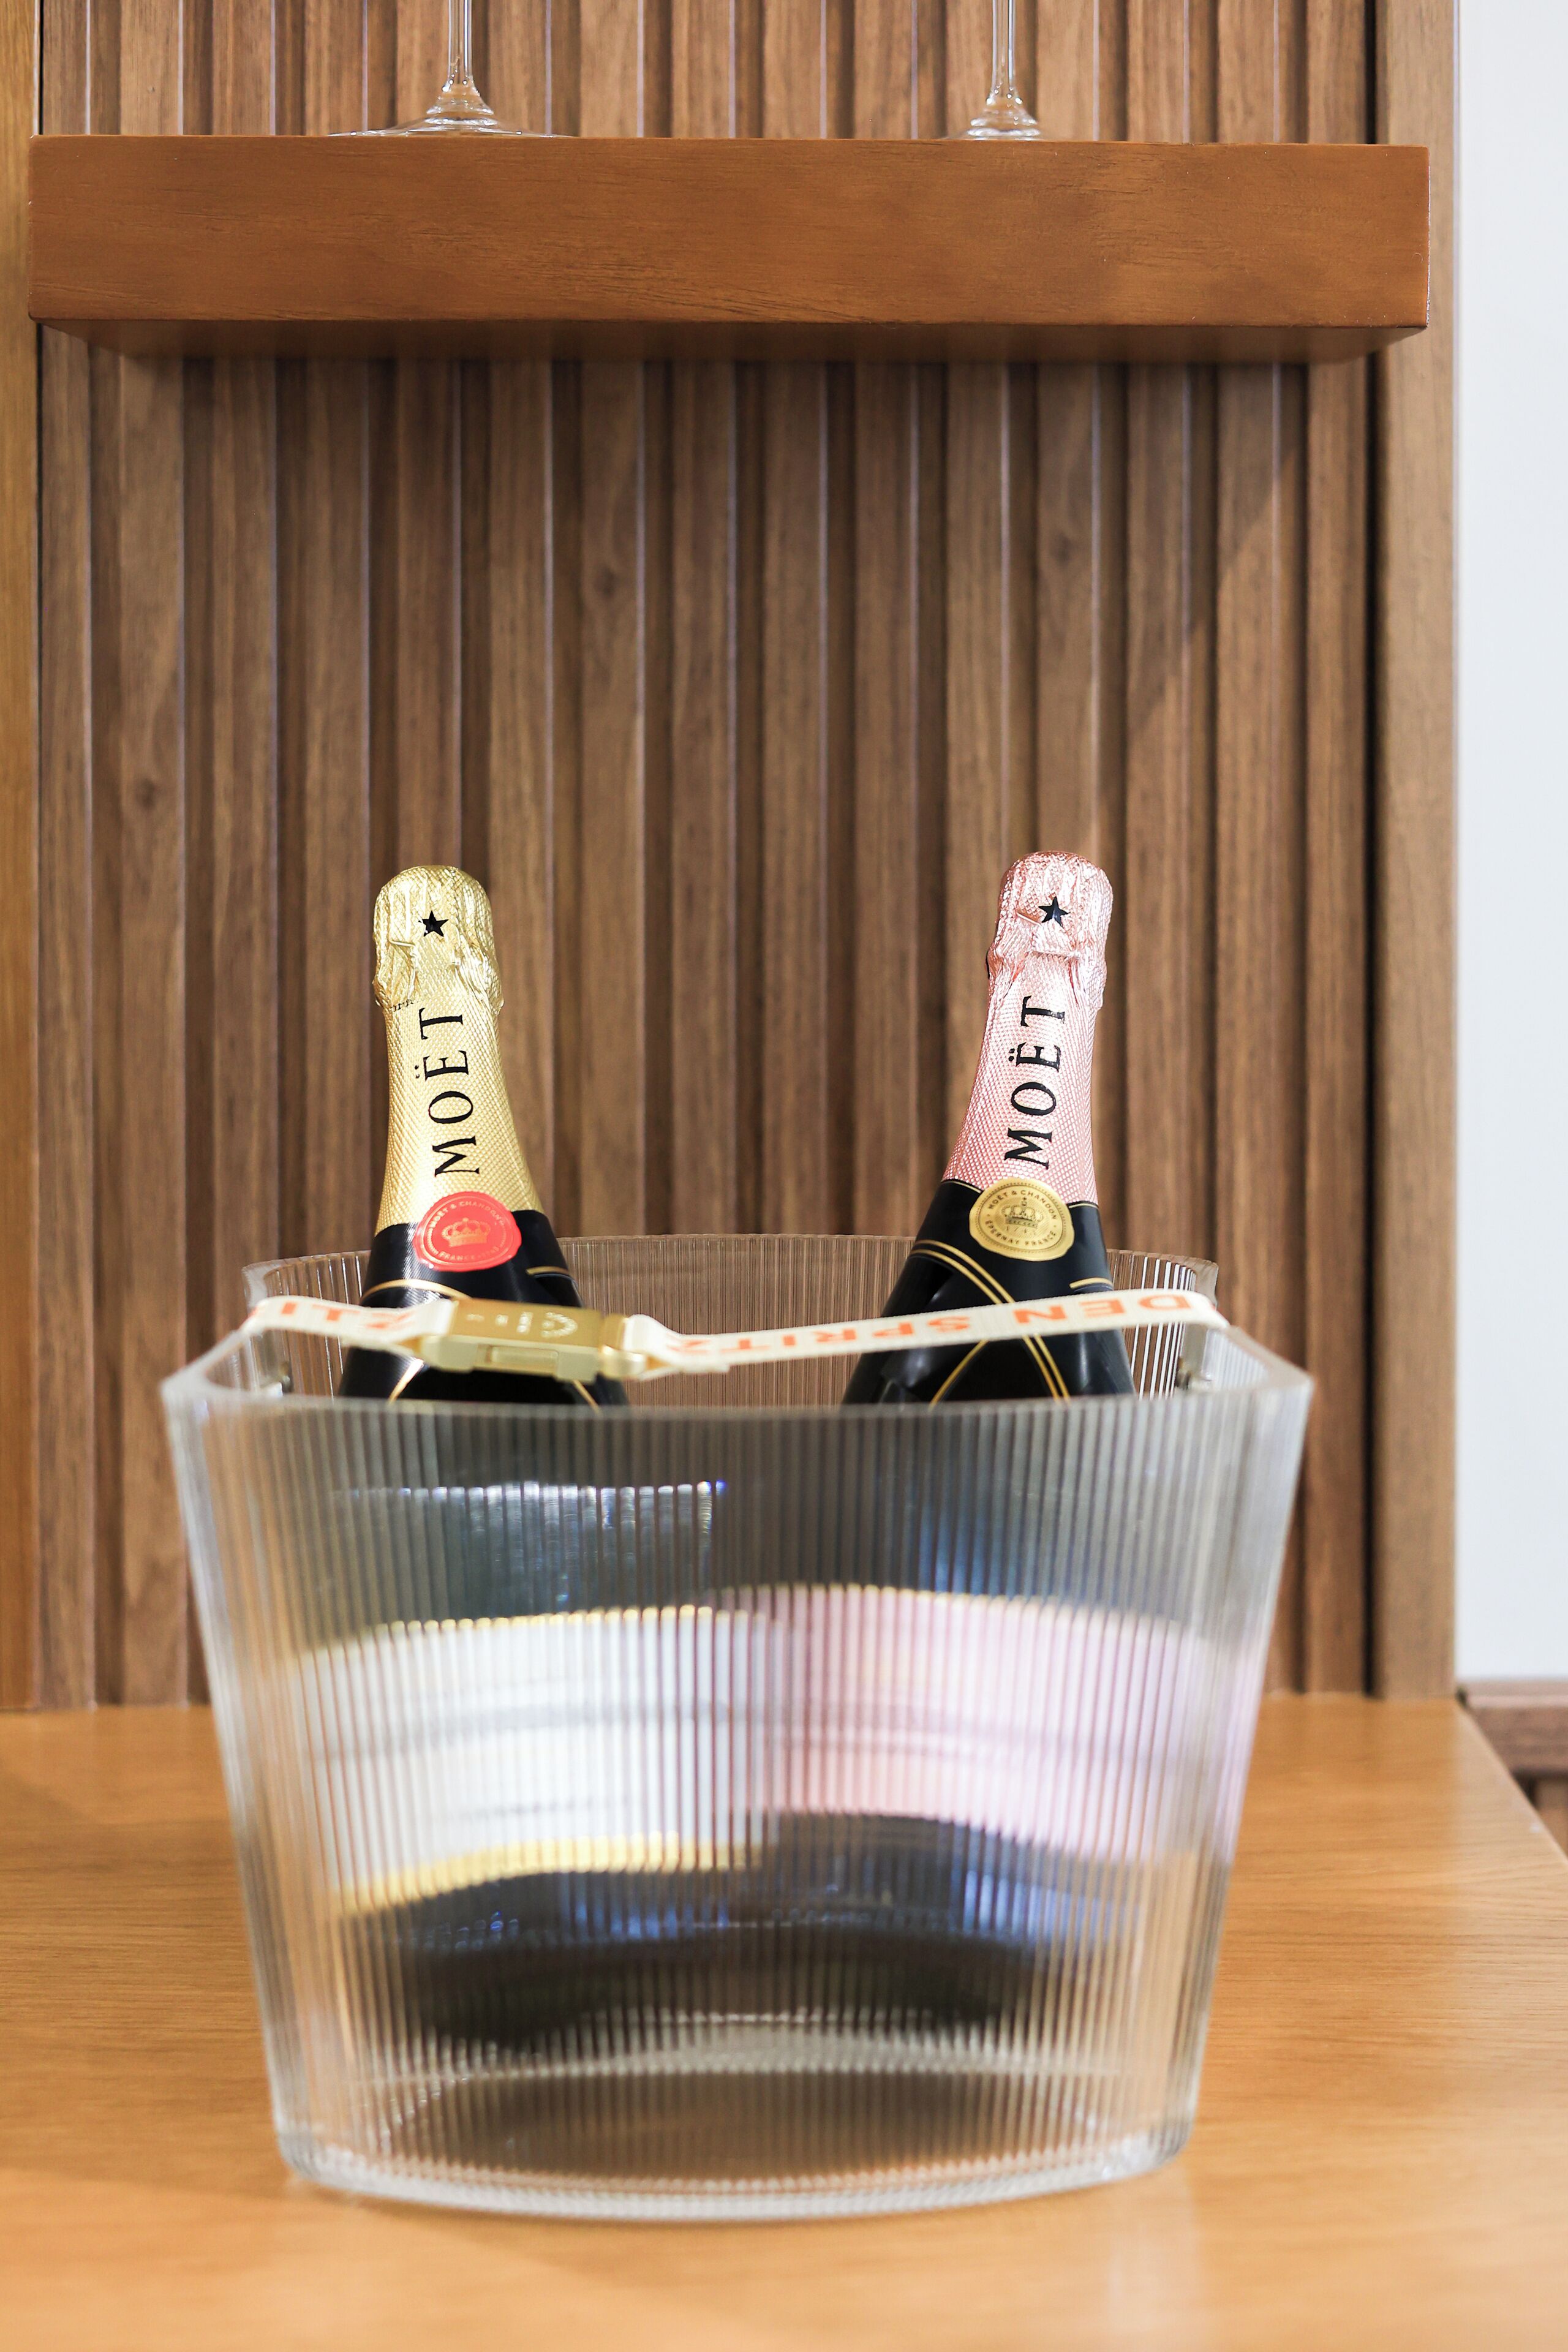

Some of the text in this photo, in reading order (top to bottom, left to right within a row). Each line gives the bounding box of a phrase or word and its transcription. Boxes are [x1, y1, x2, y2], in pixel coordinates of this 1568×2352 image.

[414, 1007, 480, 1177] MOËT
[1004, 995, 1066, 1169] MOËT
[1020, 1189, 1057, 1219] CHANDON
[1025, 1231, 1056, 1246] FRANCE
[247, 1302, 417, 1331] ITZ
[666, 1294, 1215, 1354] DEN SPRITZ
